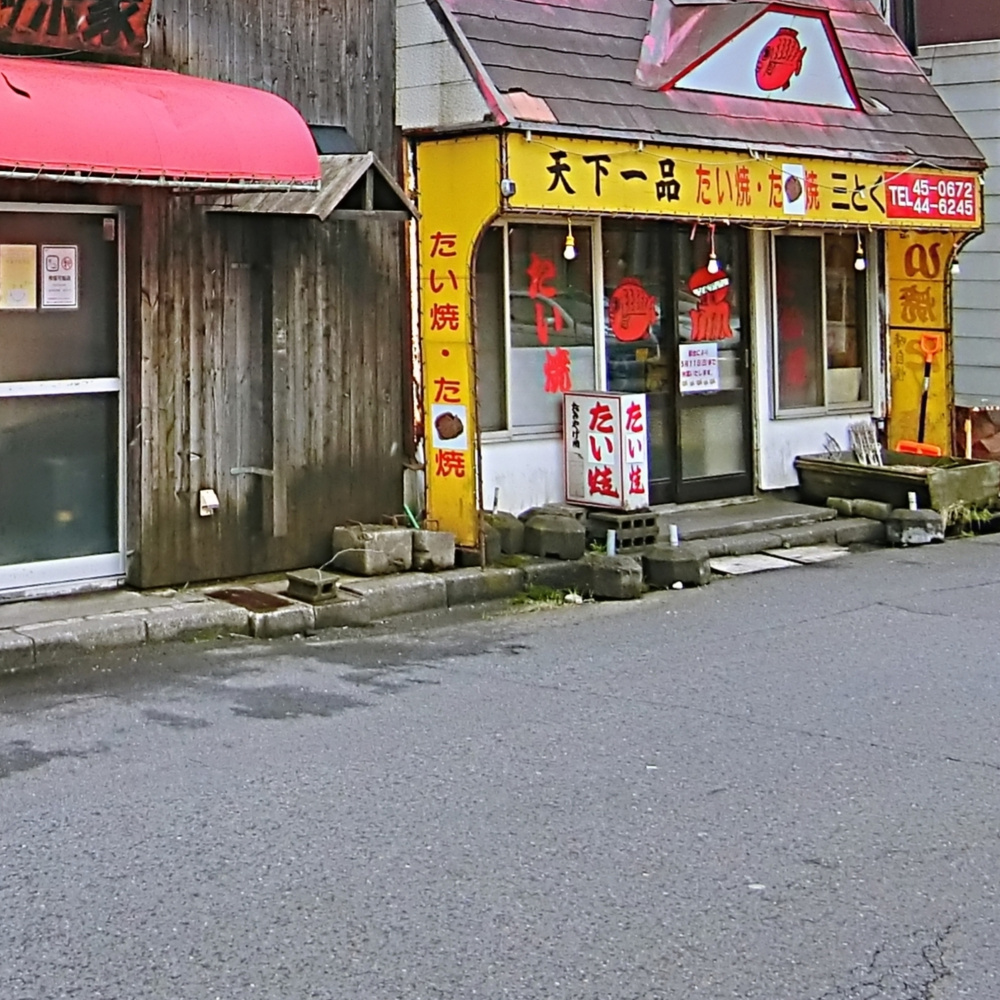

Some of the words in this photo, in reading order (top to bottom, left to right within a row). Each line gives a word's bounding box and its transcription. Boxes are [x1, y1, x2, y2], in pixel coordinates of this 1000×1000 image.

[546, 150, 681, 202] 天下一品
[889, 185, 913, 207] TEL
[912, 178, 973, 199] 45-0672
[913, 197, 974, 217] 44-6245
